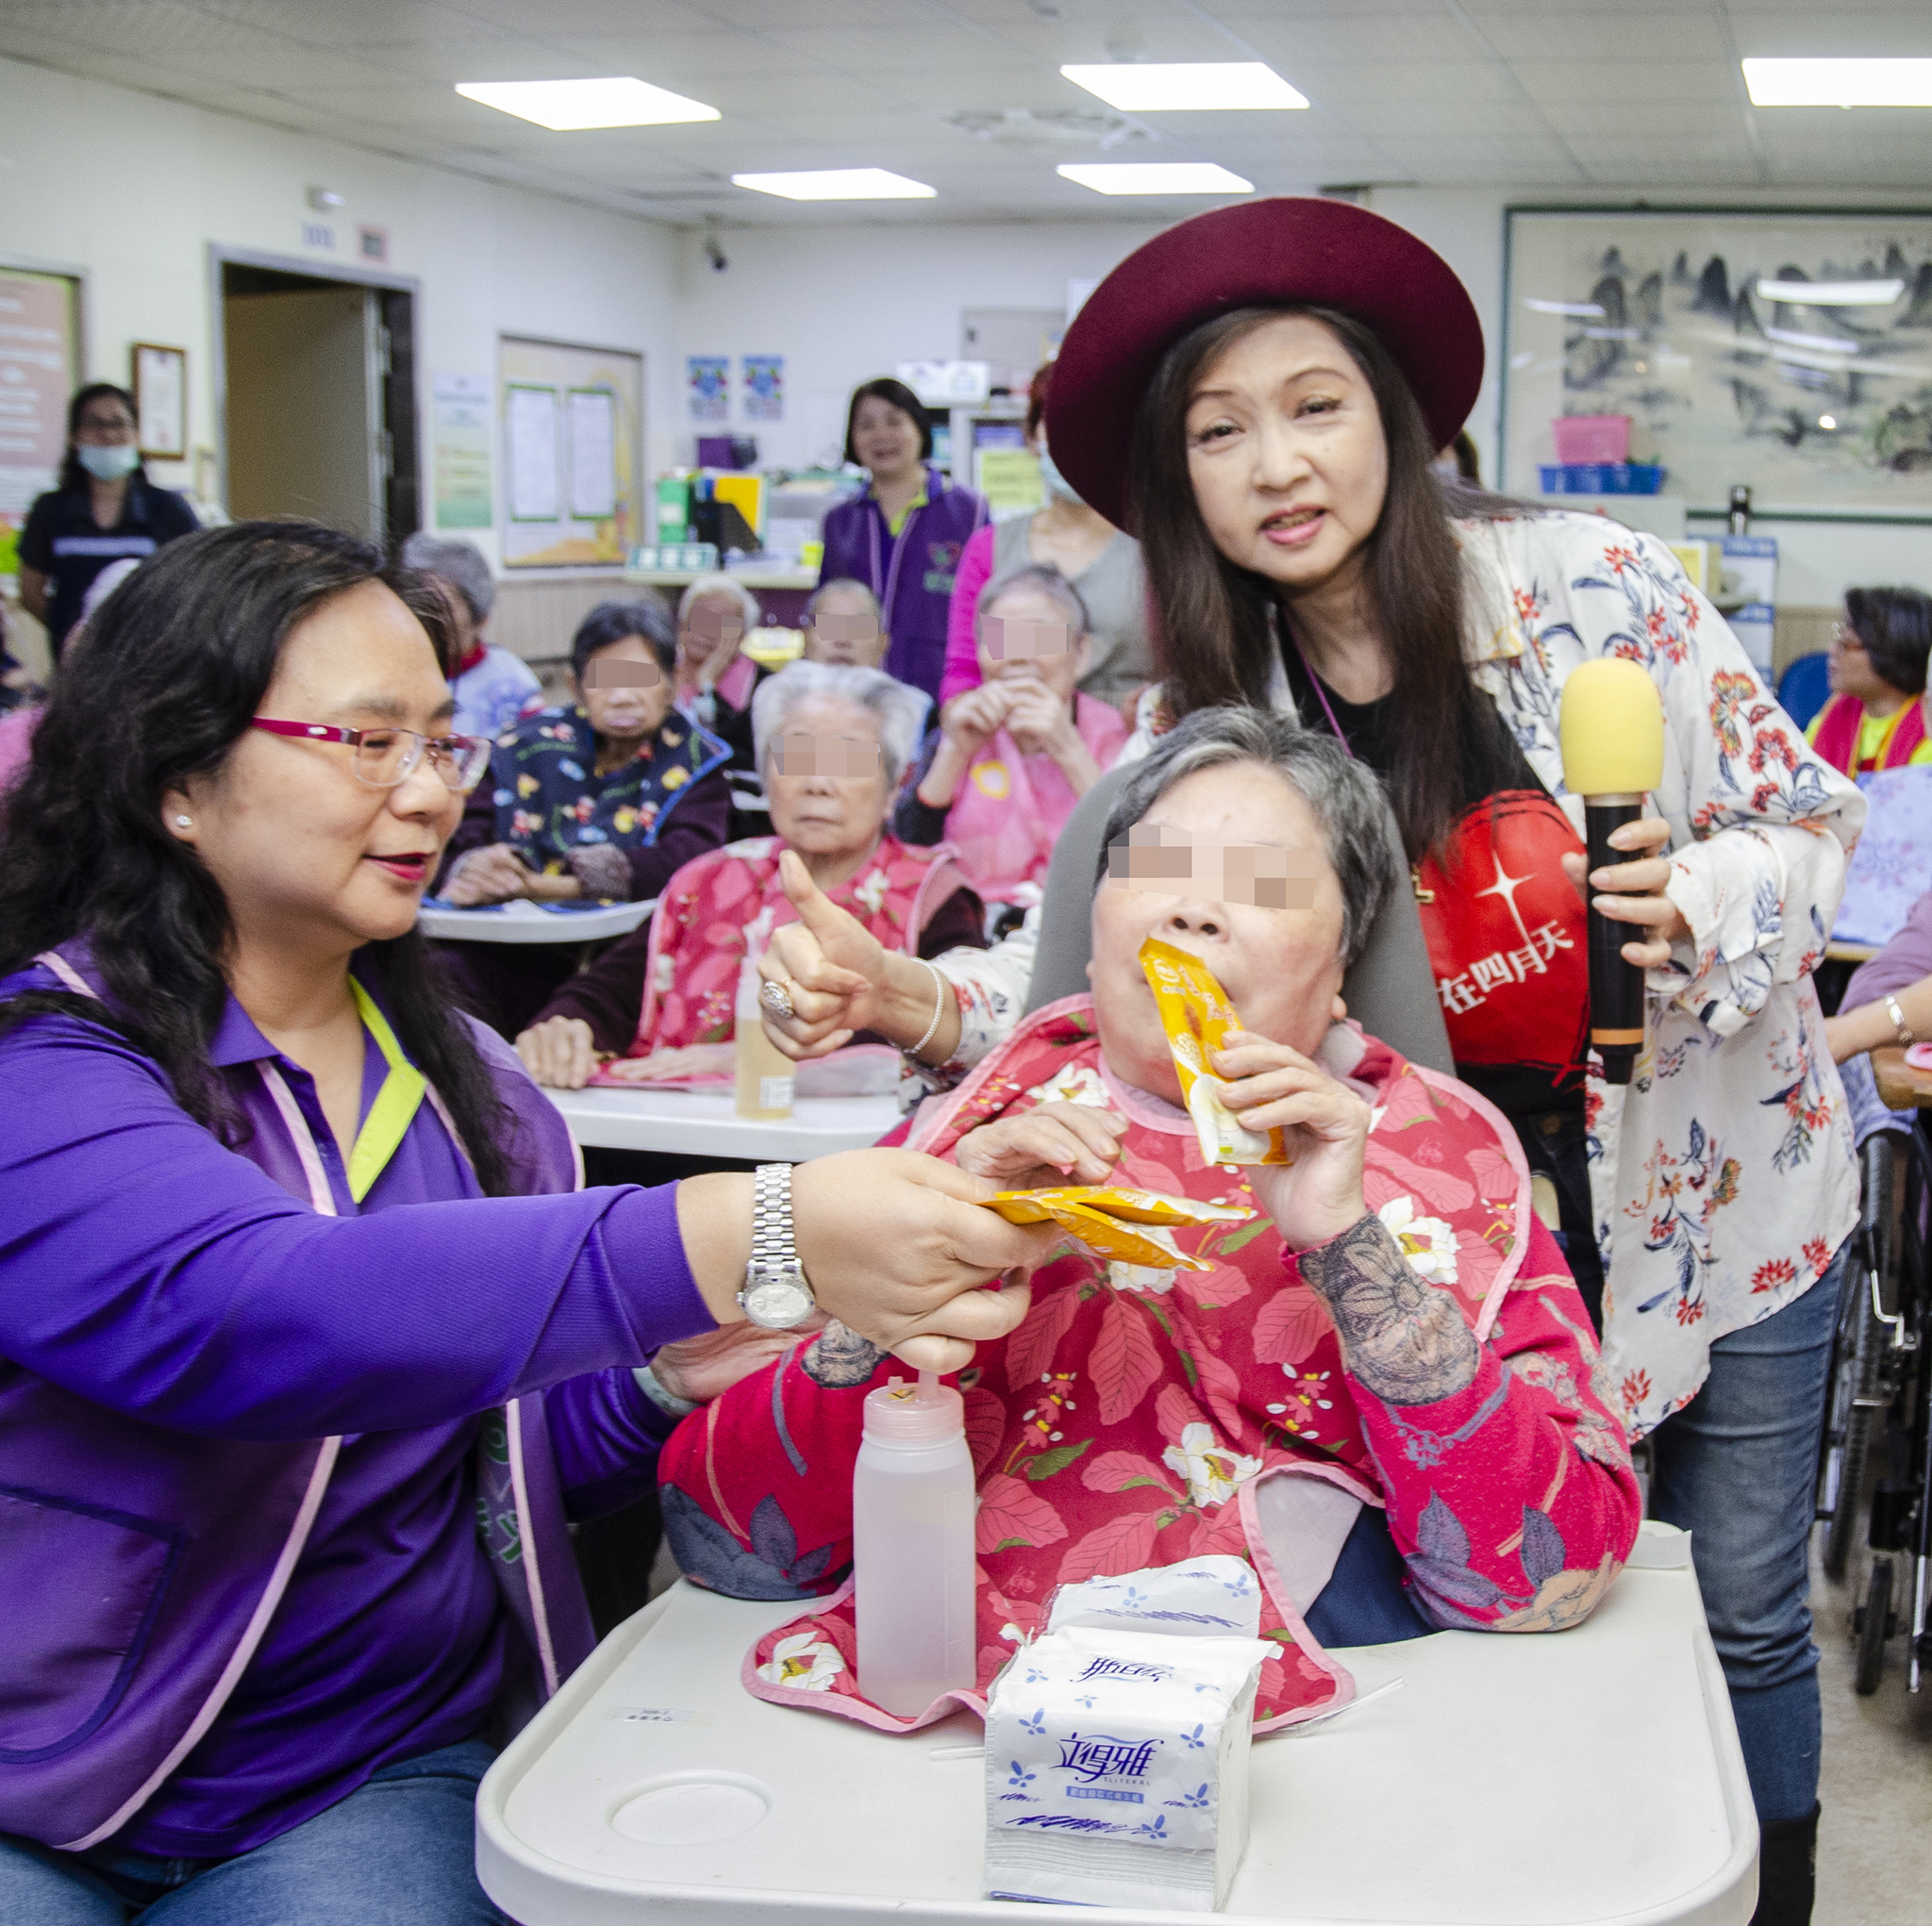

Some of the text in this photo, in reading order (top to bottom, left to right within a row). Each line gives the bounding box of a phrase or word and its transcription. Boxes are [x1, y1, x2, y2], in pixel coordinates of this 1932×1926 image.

[1437, 920, 1574, 1015] 在四月天
[1104, 1777, 1151, 1786] ELITERAL
